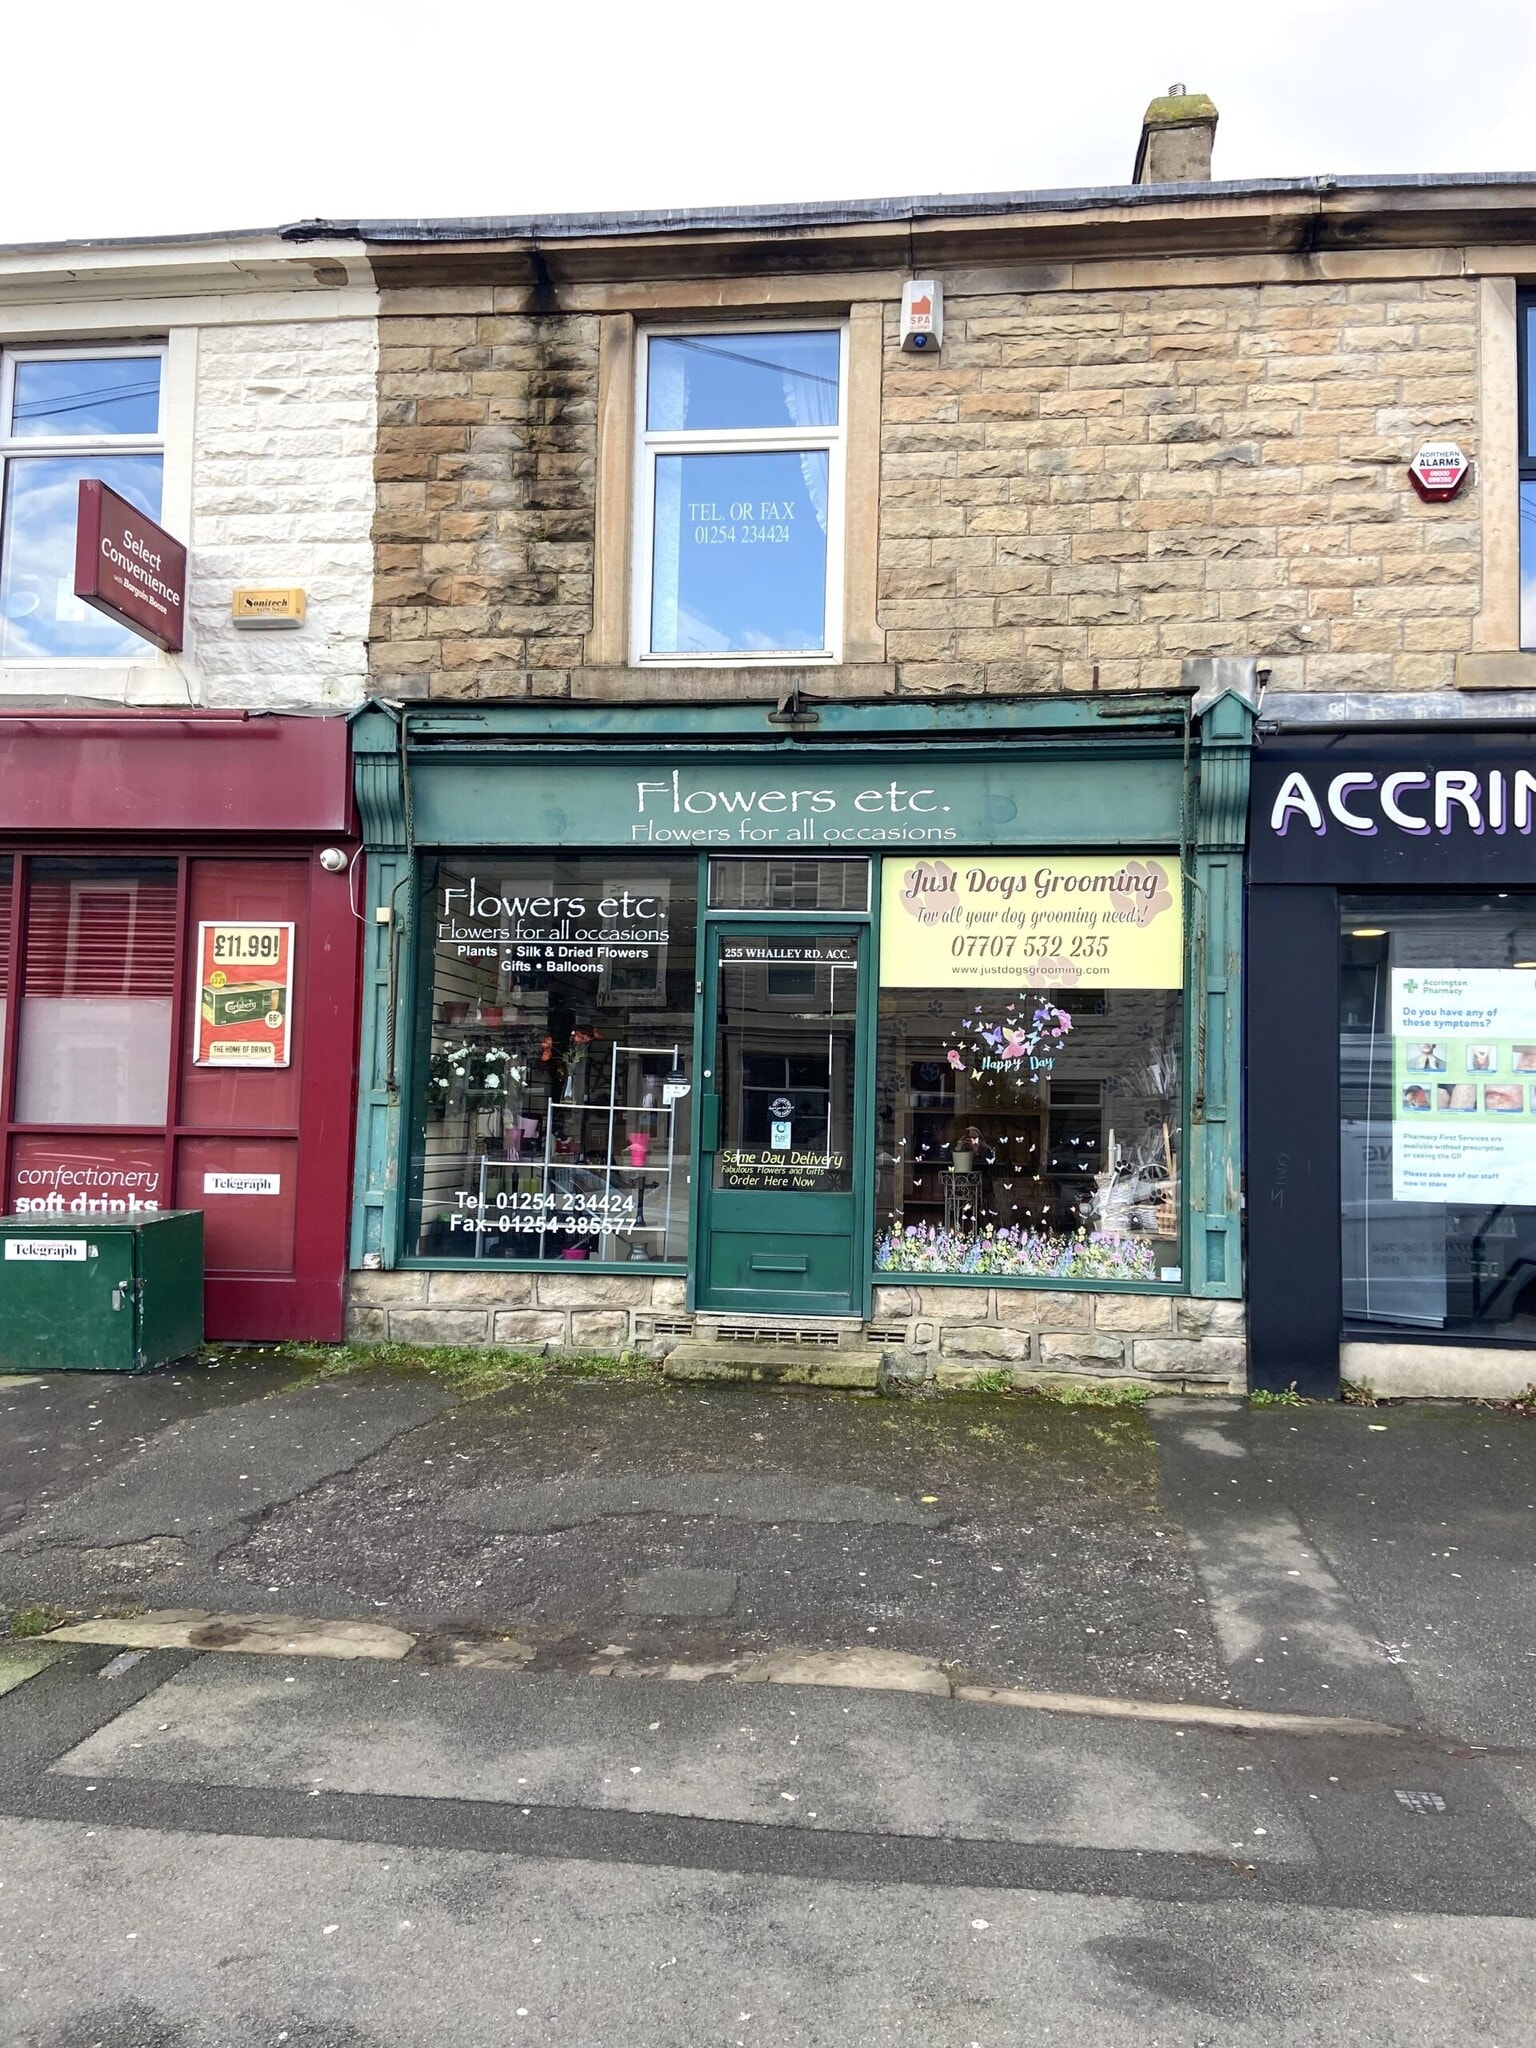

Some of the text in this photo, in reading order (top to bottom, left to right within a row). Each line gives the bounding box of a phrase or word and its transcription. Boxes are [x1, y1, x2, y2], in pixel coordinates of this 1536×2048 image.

[910, 316, 931, 325] SPA
[1419, 458, 1460, 467] ALARMS
[688, 502, 796, 521] TEL. OR FAX
[695, 525, 790, 544] 01254 234424
[123, 530, 161, 571] Select
[101, 537, 180, 606] Convenience
[123, 577, 149, 602] Bargain
[148, 594, 168, 615] Booze
[244, 598, 288, 608] Sonitech
[636, 769, 951, 814] Flowers etc.
[631, 818, 957, 841] Flowers for all occasions
[905, 868, 1159, 900] Just Dogs Grooming
[443, 877, 666, 919] Flowers etc.
[941, 906, 963, 923] all
[965, 913, 999, 929] your
[1001, 906, 1026, 929] dog
[1030, 907, 1098, 929] grooming
[438, 918, 670, 941] Flowers for all occasions
[214, 934, 279, 958] £11.99!
[457, 945, 649, 959] Plants Silk & Dried Flowers
[725, 948, 851, 959] 255 WHALLEY RD. ACC.
[951, 935, 1110, 957] 07707 532 235
[501, 961, 604, 973] Gifts Balloons
[951, 965, 1110, 976] www.justdogsgrooming.com
[1423, 979, 1468, 988] Accrington
[1423, 987, 1463, 996] Pharmacy
[225, 999, 257, 1014] Carlsberg
[1403, 1007, 1498, 1018] Do you have any of
[1403, 1018, 1491, 1029] these symptoms?
[213, 1045, 224, 1053] THE
[225, 1045, 241, 1053] HOME
[251, 1045, 272, 1053] DRINKS
[981, 1056, 1055, 1073] Happy Day
[1403, 1133, 1438, 1142] Pharmacy
[1463, 1144, 1504, 1152] prescription
[722, 1150, 843, 1169] Same Day Delivery
[1413, 1152, 1436, 1160] seeing
[721, 1165, 825, 1175] Fabulous Flowers and Gifts
[17, 1165, 159, 1192] confectionery
[212, 1178, 271, 1191] Telegraph
[729, 1174, 816, 1187] Order Here Now
[15, 1192, 158, 1212] soft drinks
[455, 1192, 634, 1212] Tel. 01254 234424
[450, 1214, 637, 1235] Fax. 01254 385577
[13, 1244, 77, 1258] Telegraph
